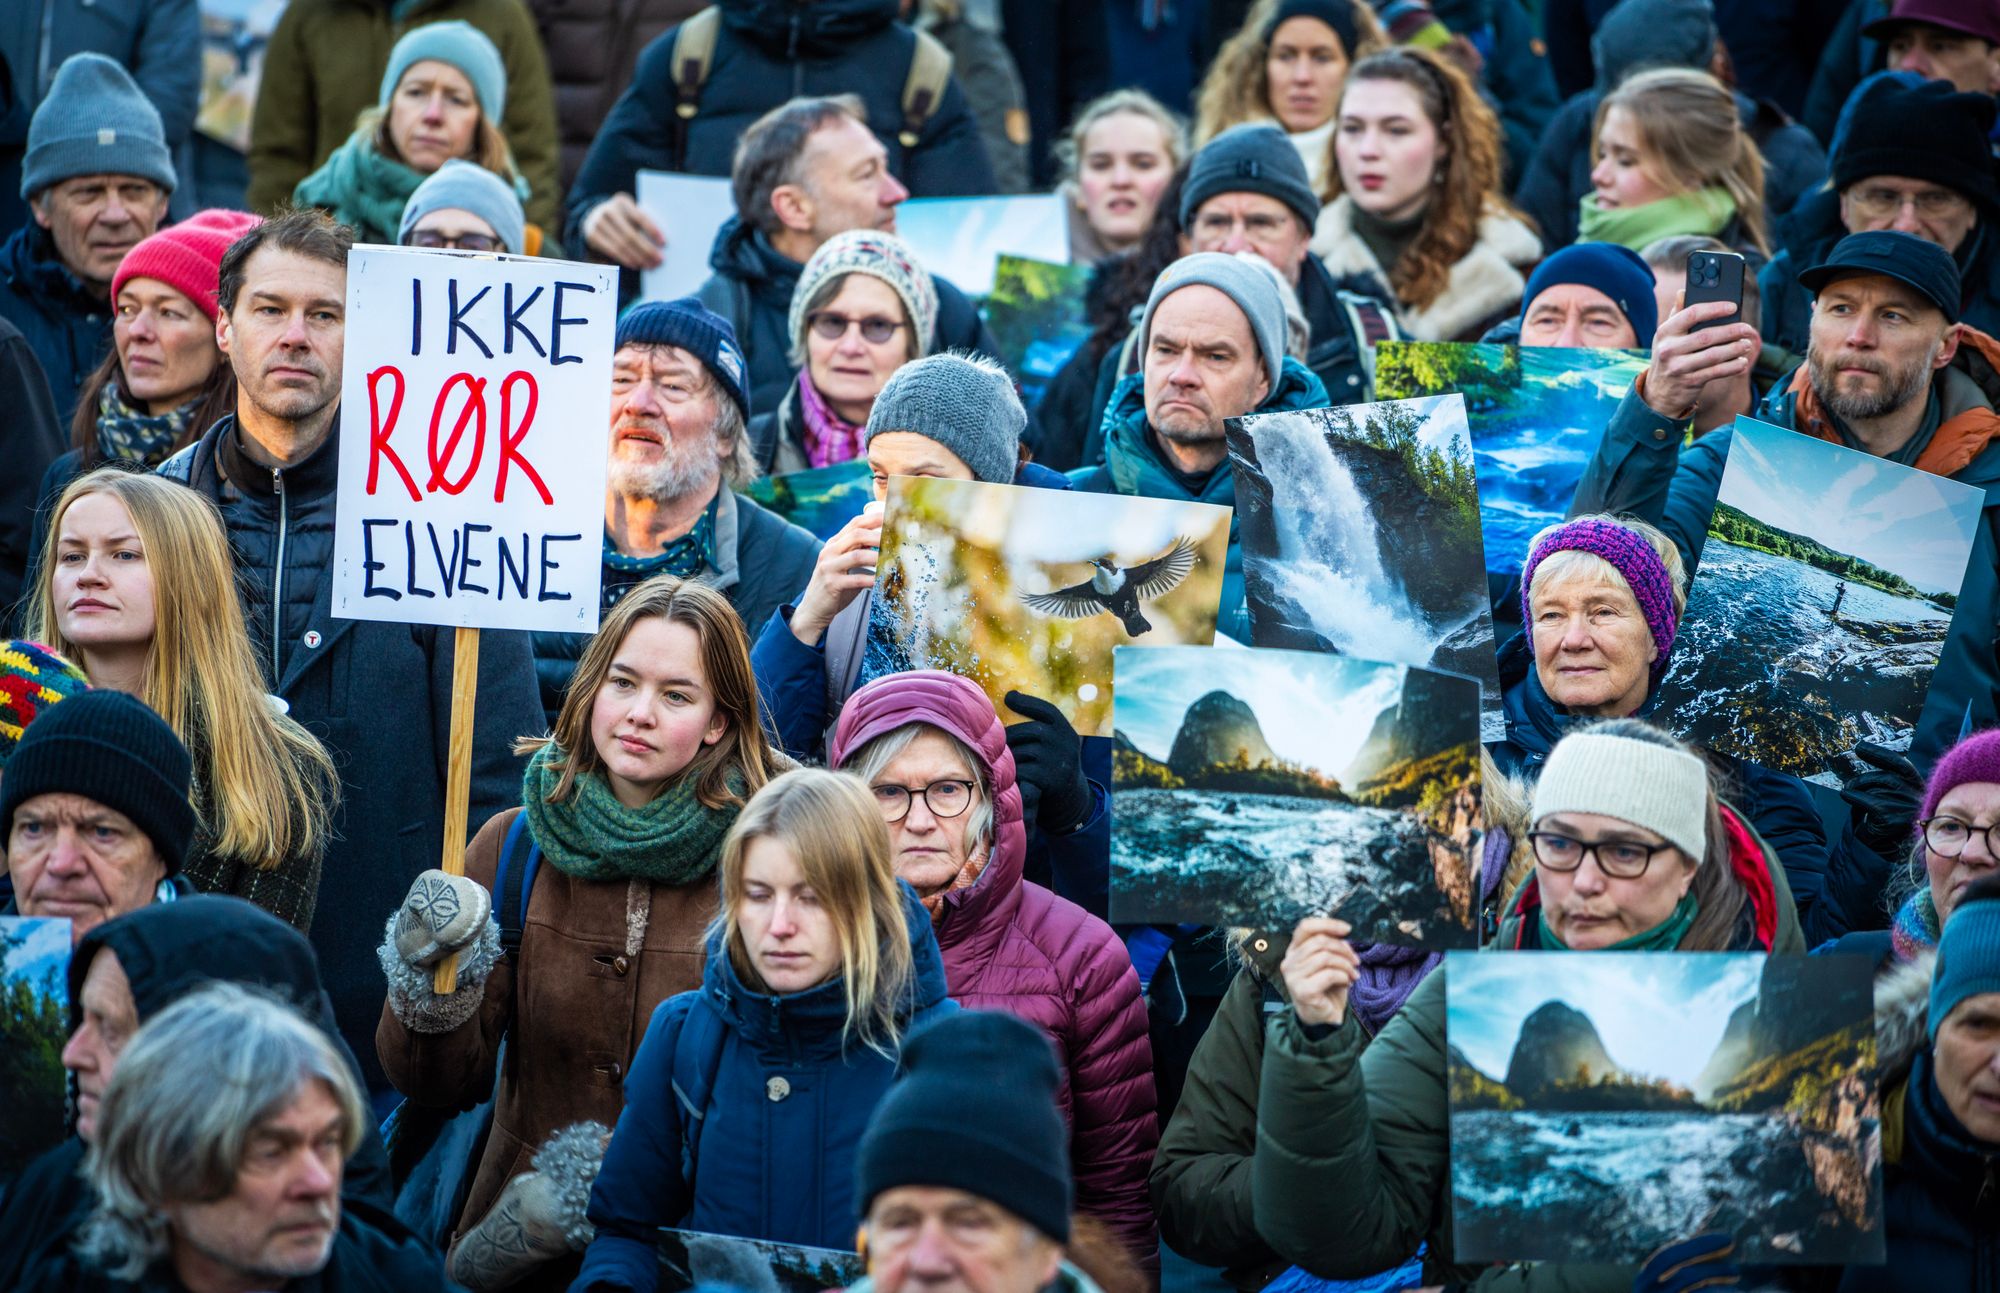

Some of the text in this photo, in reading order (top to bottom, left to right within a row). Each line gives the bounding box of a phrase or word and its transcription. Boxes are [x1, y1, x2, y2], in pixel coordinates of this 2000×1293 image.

[411, 278, 596, 365] IKKE
[366, 365, 554, 506] RØR
[361, 518, 582, 602] ELVENE
